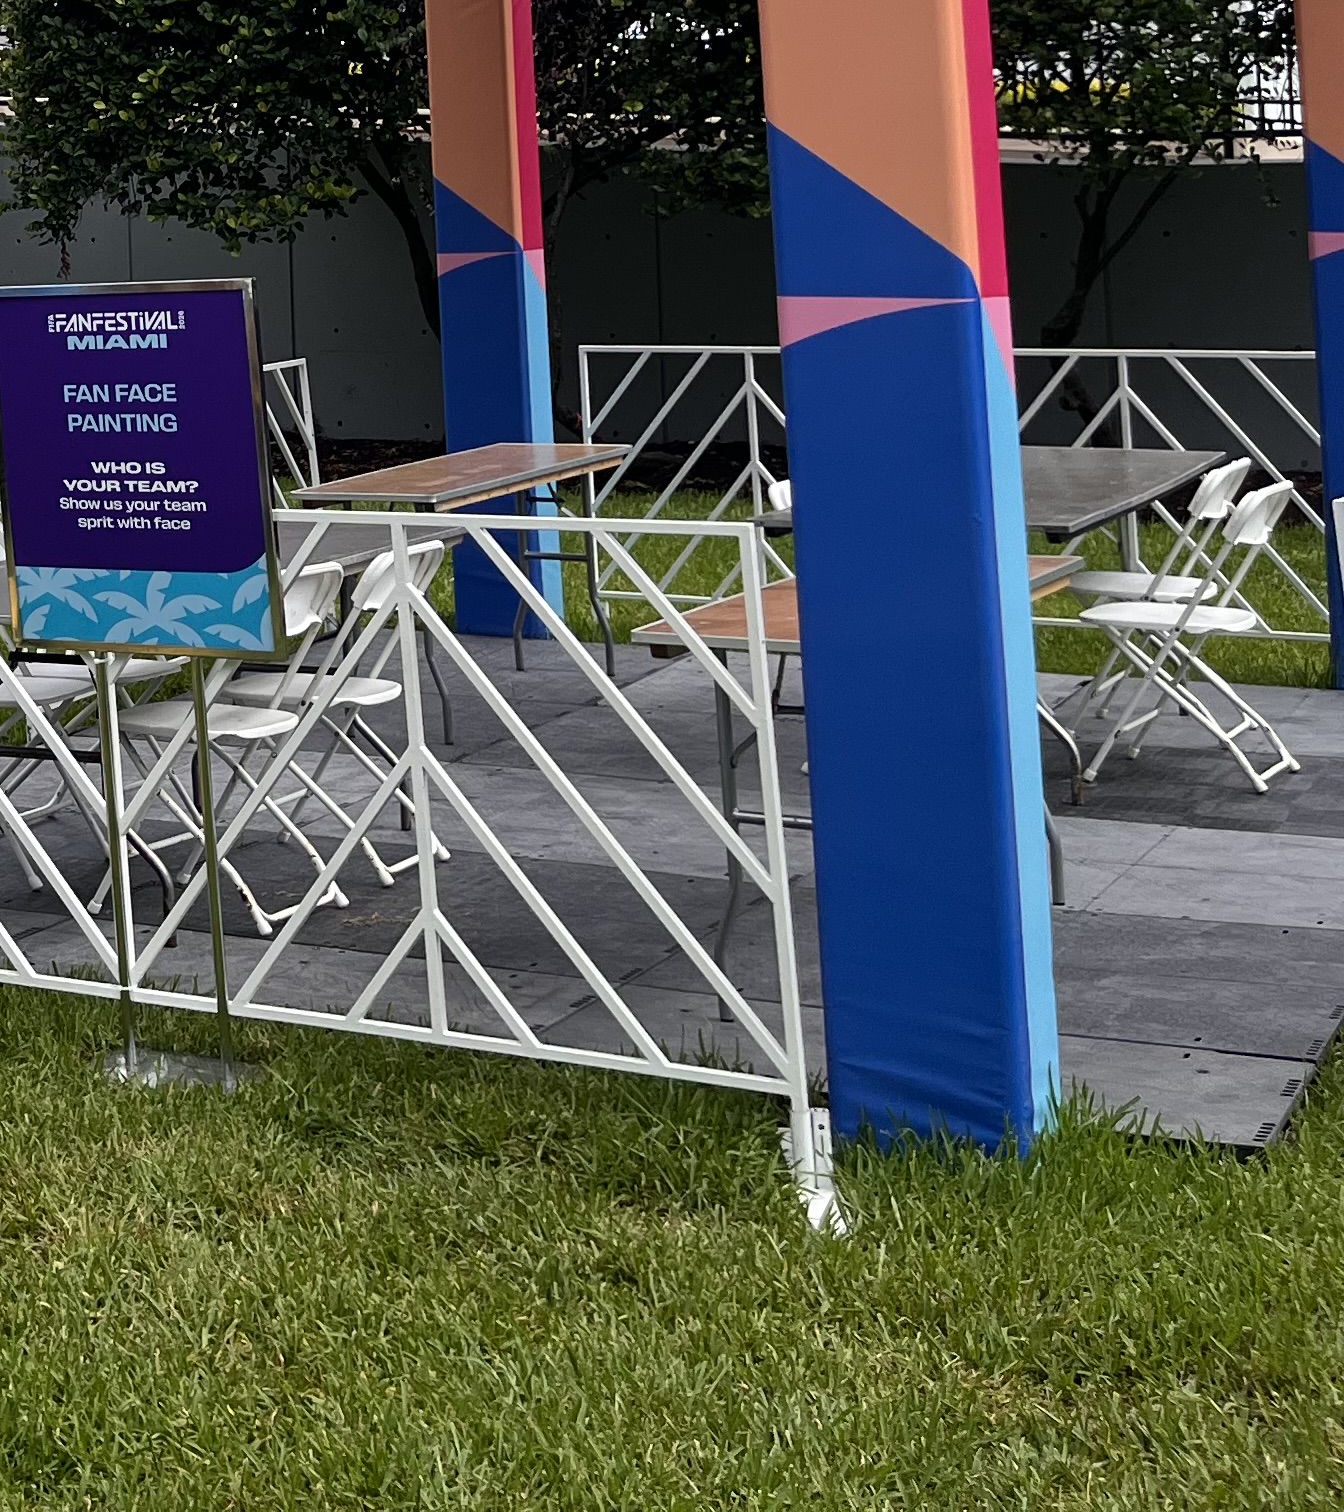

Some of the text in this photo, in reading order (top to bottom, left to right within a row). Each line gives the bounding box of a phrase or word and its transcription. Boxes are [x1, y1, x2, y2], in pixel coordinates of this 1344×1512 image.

[66, 333, 168, 350] MIAMI
[63, 383, 178, 403] FAN FACE
[67, 413, 178, 433] PAINTING
[91, 461, 166, 475] WHO IS
[63, 479, 199, 494] YOUR TEAM?
[59, 496, 207, 514] Show us your team
[77, 515, 191, 531] sprit with face
